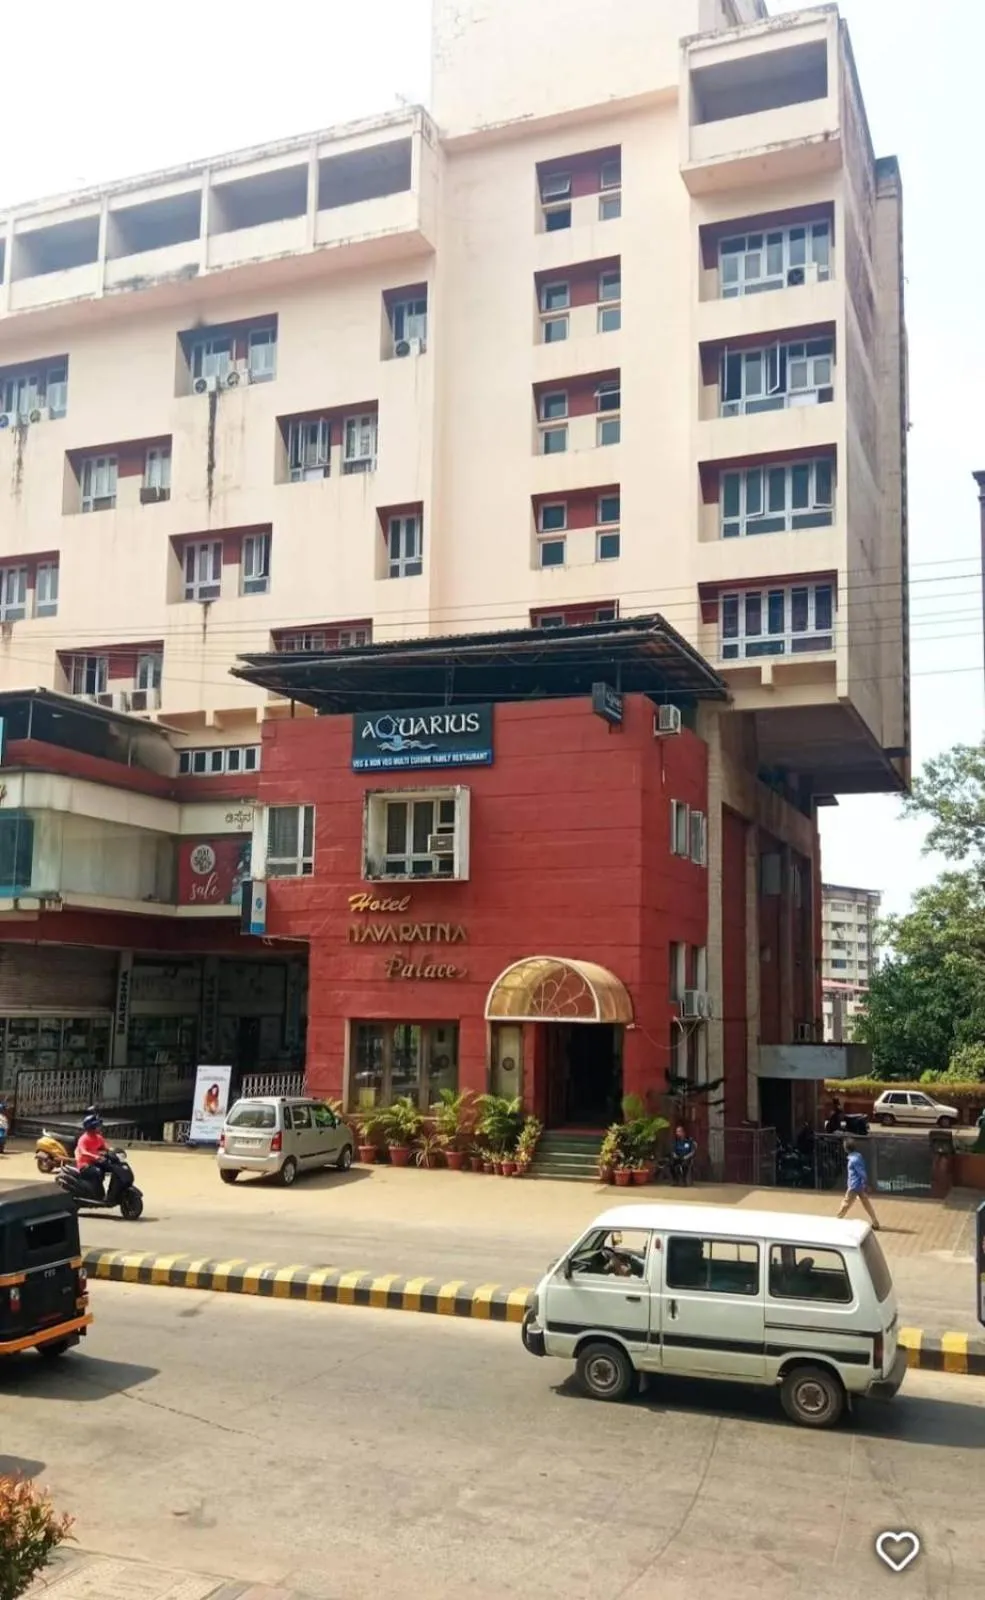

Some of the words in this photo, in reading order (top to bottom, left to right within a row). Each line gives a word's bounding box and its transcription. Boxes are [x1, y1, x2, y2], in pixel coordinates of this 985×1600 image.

[361, 712, 480, 739] AQUARIUS
[353, 759, 364, 768] VEG
[370, 758, 381, 767] NON
[382, 758, 392, 766] VEG
[393, 757, 409, 766] MULTI
[410, 756, 431, 765] CUISINE
[432, 754, 451, 763] FAMILY
[452, 752, 488, 762] RESTAURANT
[348, 893, 411, 912] Hotel
[346, 922, 467, 942] NAVARATNA
[385, 951, 467, 978] Palace
